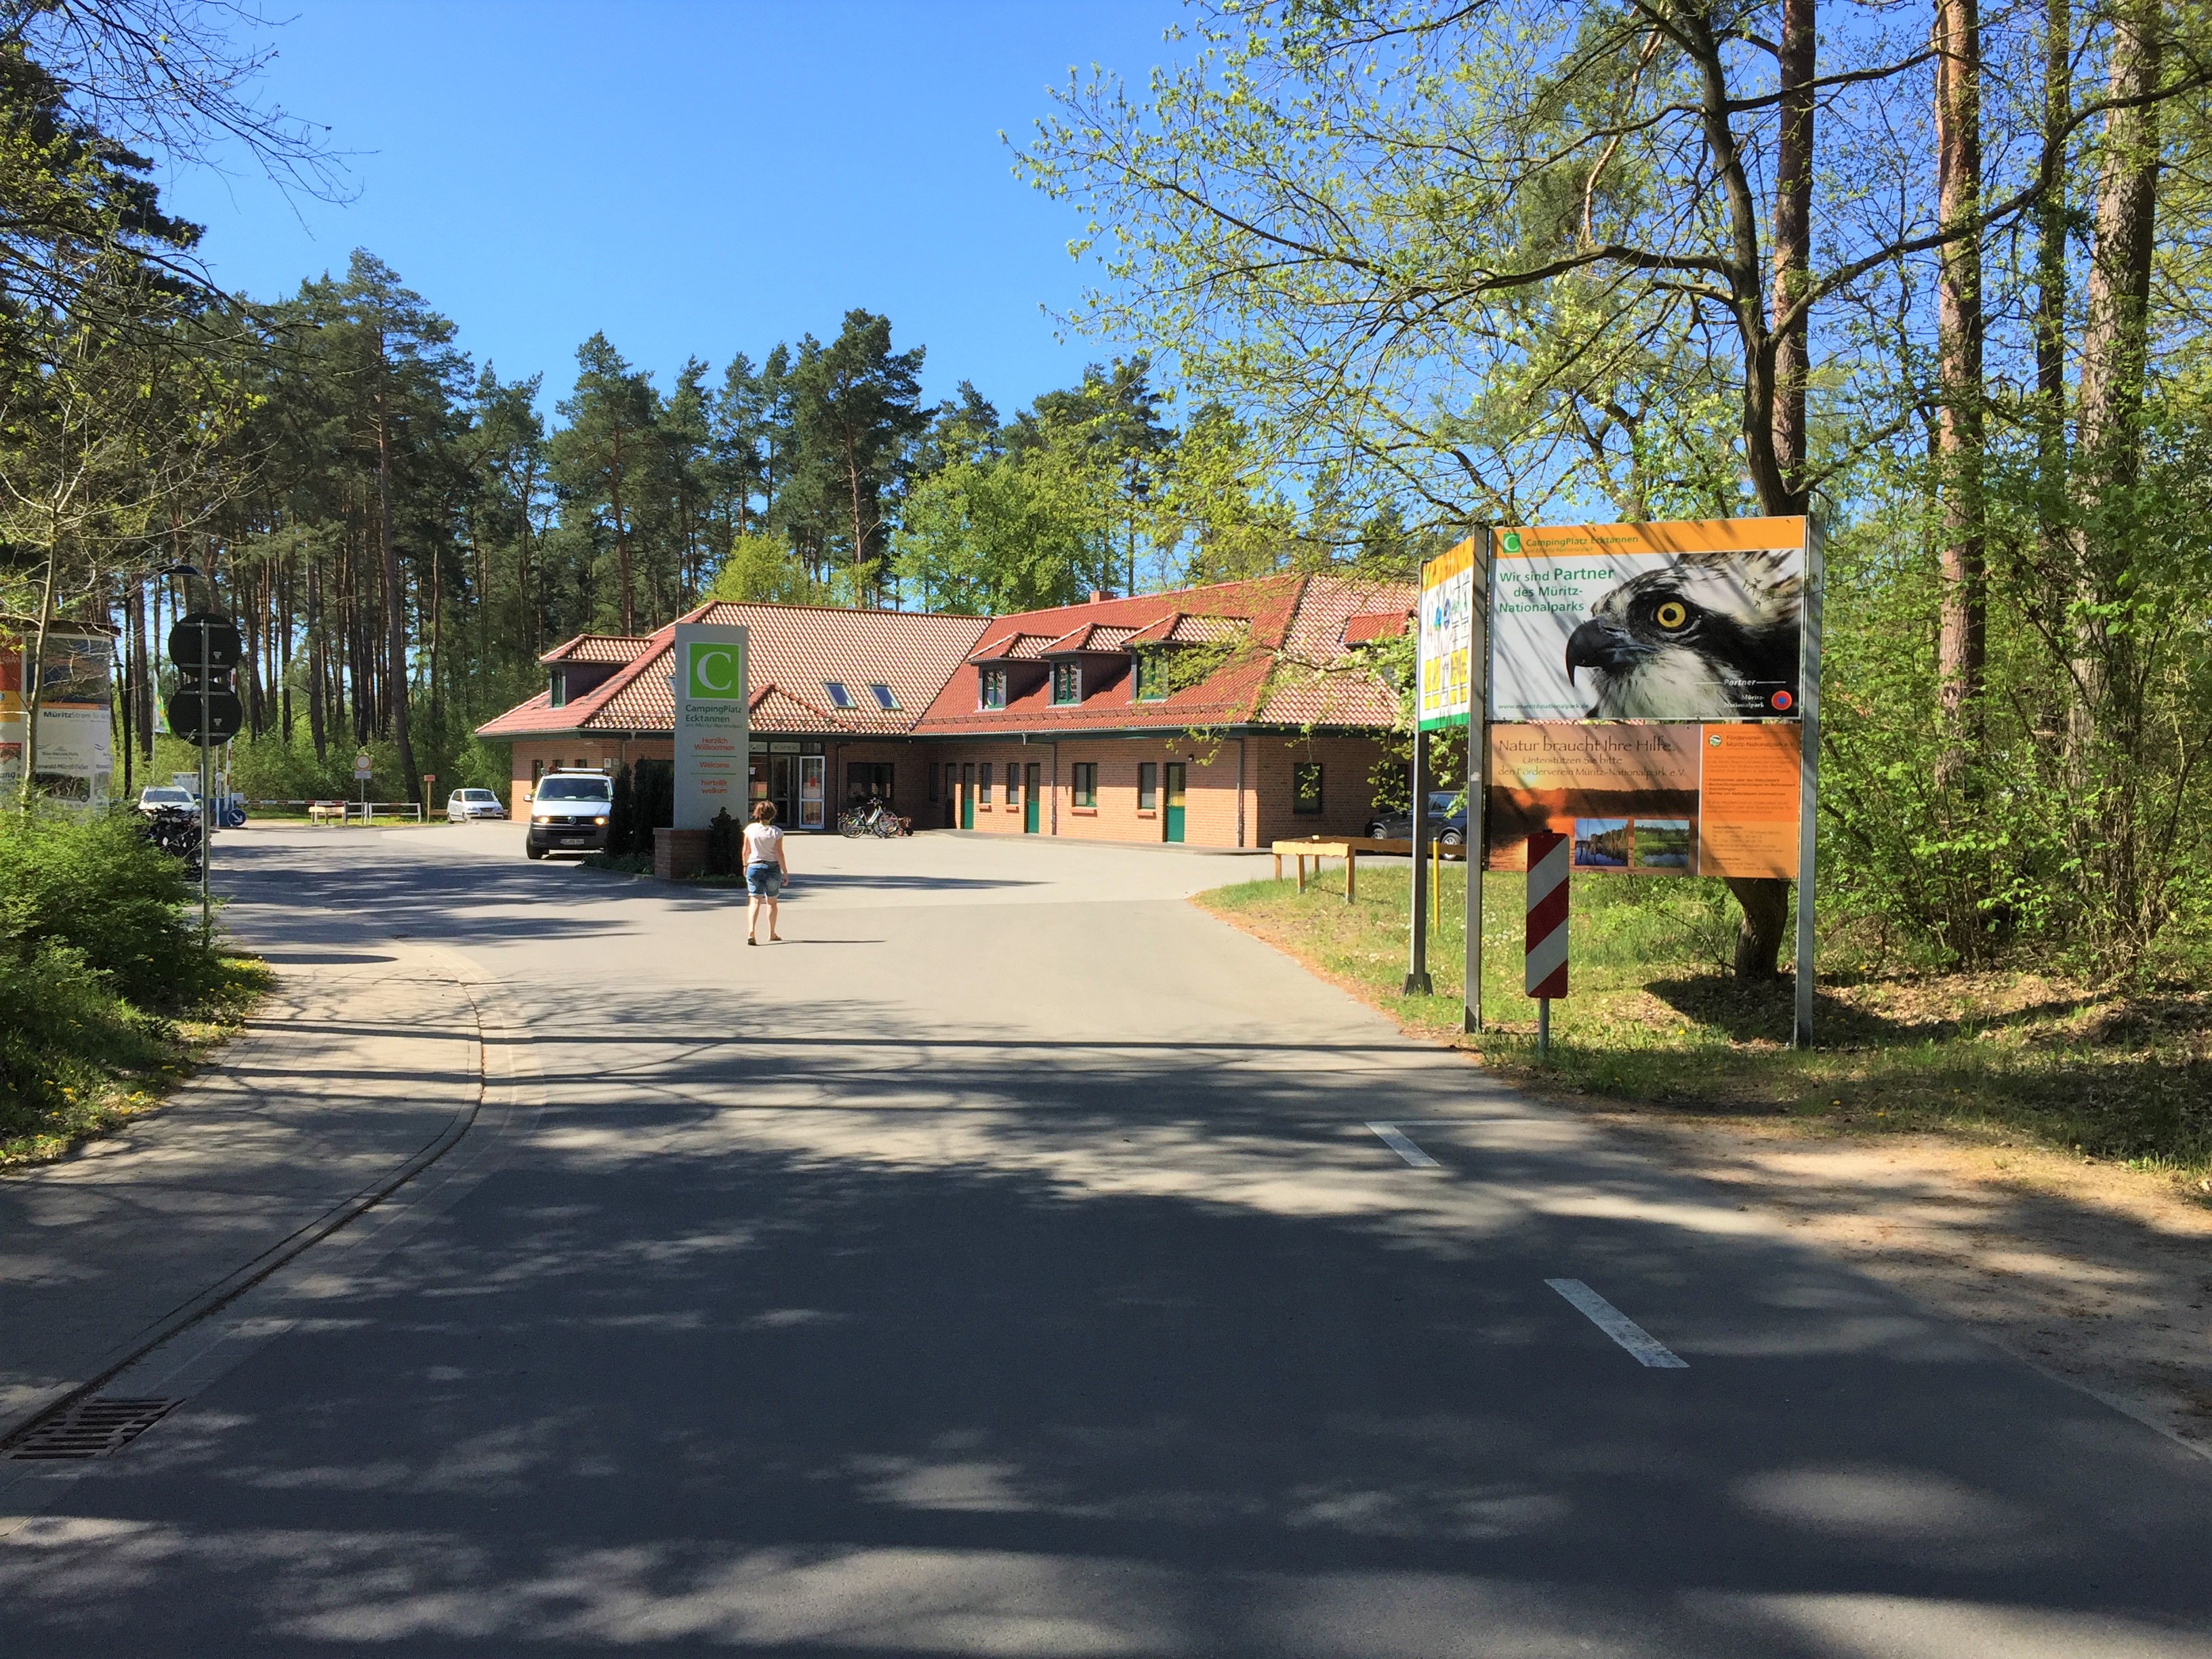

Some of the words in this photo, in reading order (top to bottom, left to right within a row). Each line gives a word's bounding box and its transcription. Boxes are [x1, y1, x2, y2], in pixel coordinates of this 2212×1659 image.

[1525, 537, 1588, 550] CampingPlatz
[1591, 536, 1639, 545] Ecktannen
[1500, 571, 1521, 582] Wir
[1524, 571, 1549, 581] sind
[1554, 568, 1615, 581] Partner
[1513, 586, 1534, 597] des
[1538, 586, 1583, 596] Müritz-
[1499, 600, 1584, 614] Nationalparks
[697, 651, 732, 691] C
[685, 704, 742, 714] CampingPlatz
[685, 714, 730, 722] Ecktannen
[1499, 739, 1539, 752] Natur
[1543, 735, 1600, 752] braucht
[1604, 735, 1633, 752] Ihre
[1637, 735, 1676, 752] Hilfe.
[1523, 756, 1581, 765] Unterstützen
[1583, 756, 1597, 764] Sie
[1599, 754, 1623, 764] bitte
[1498, 766, 1515, 776] den
[1516, 766, 1574, 777] Förderverein
[1576, 767, 1667, 780] Müritz-Nationalpark
